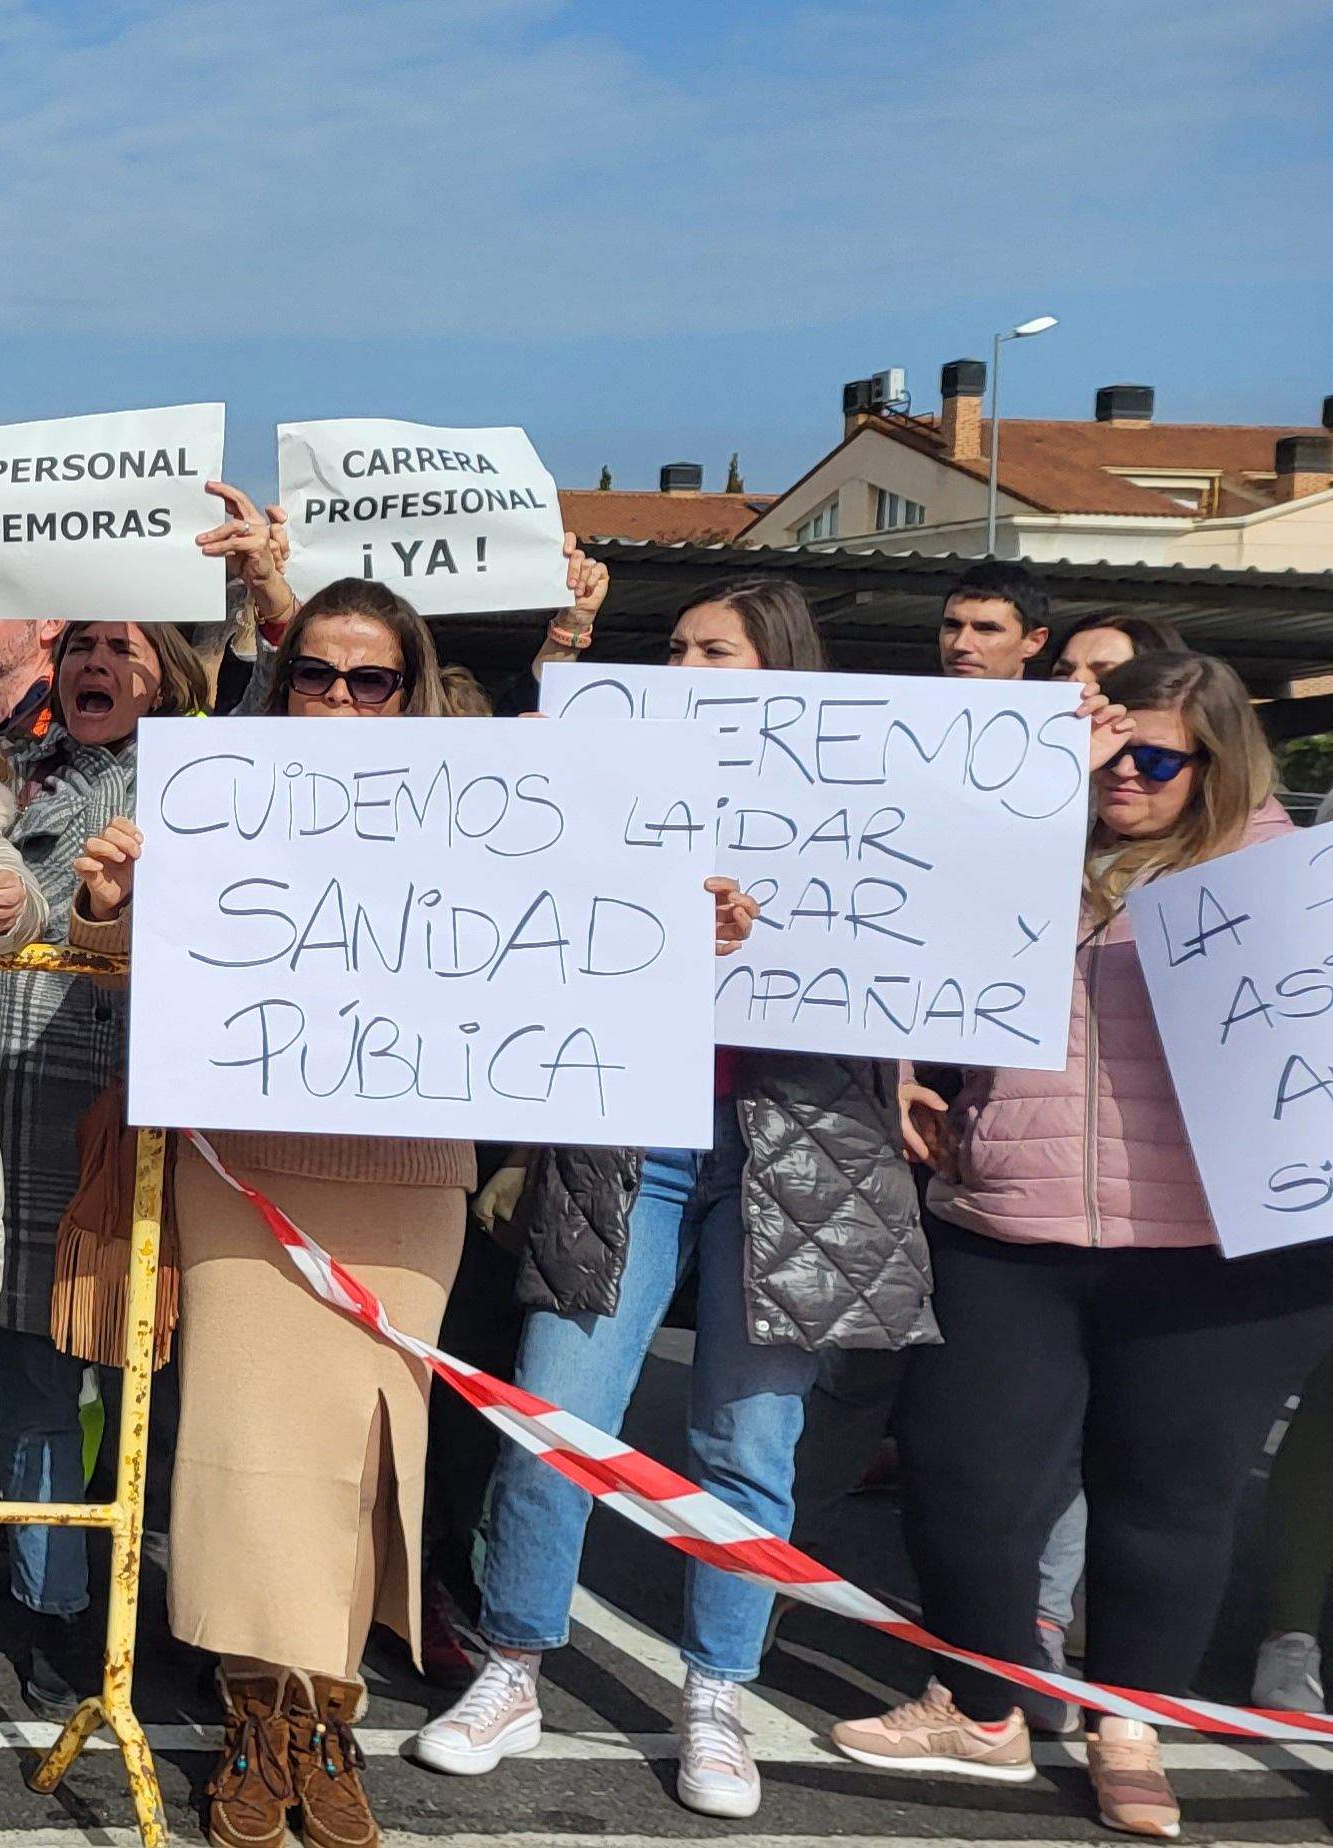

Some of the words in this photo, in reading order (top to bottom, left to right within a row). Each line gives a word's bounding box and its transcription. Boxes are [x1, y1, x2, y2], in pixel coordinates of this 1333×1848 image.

[342, 447, 499, 479] CARRERA
[304, 486, 547, 524] PROFESIONAL
[624, 797, 705, 852] LA
[1157, 886, 1251, 968] LA
